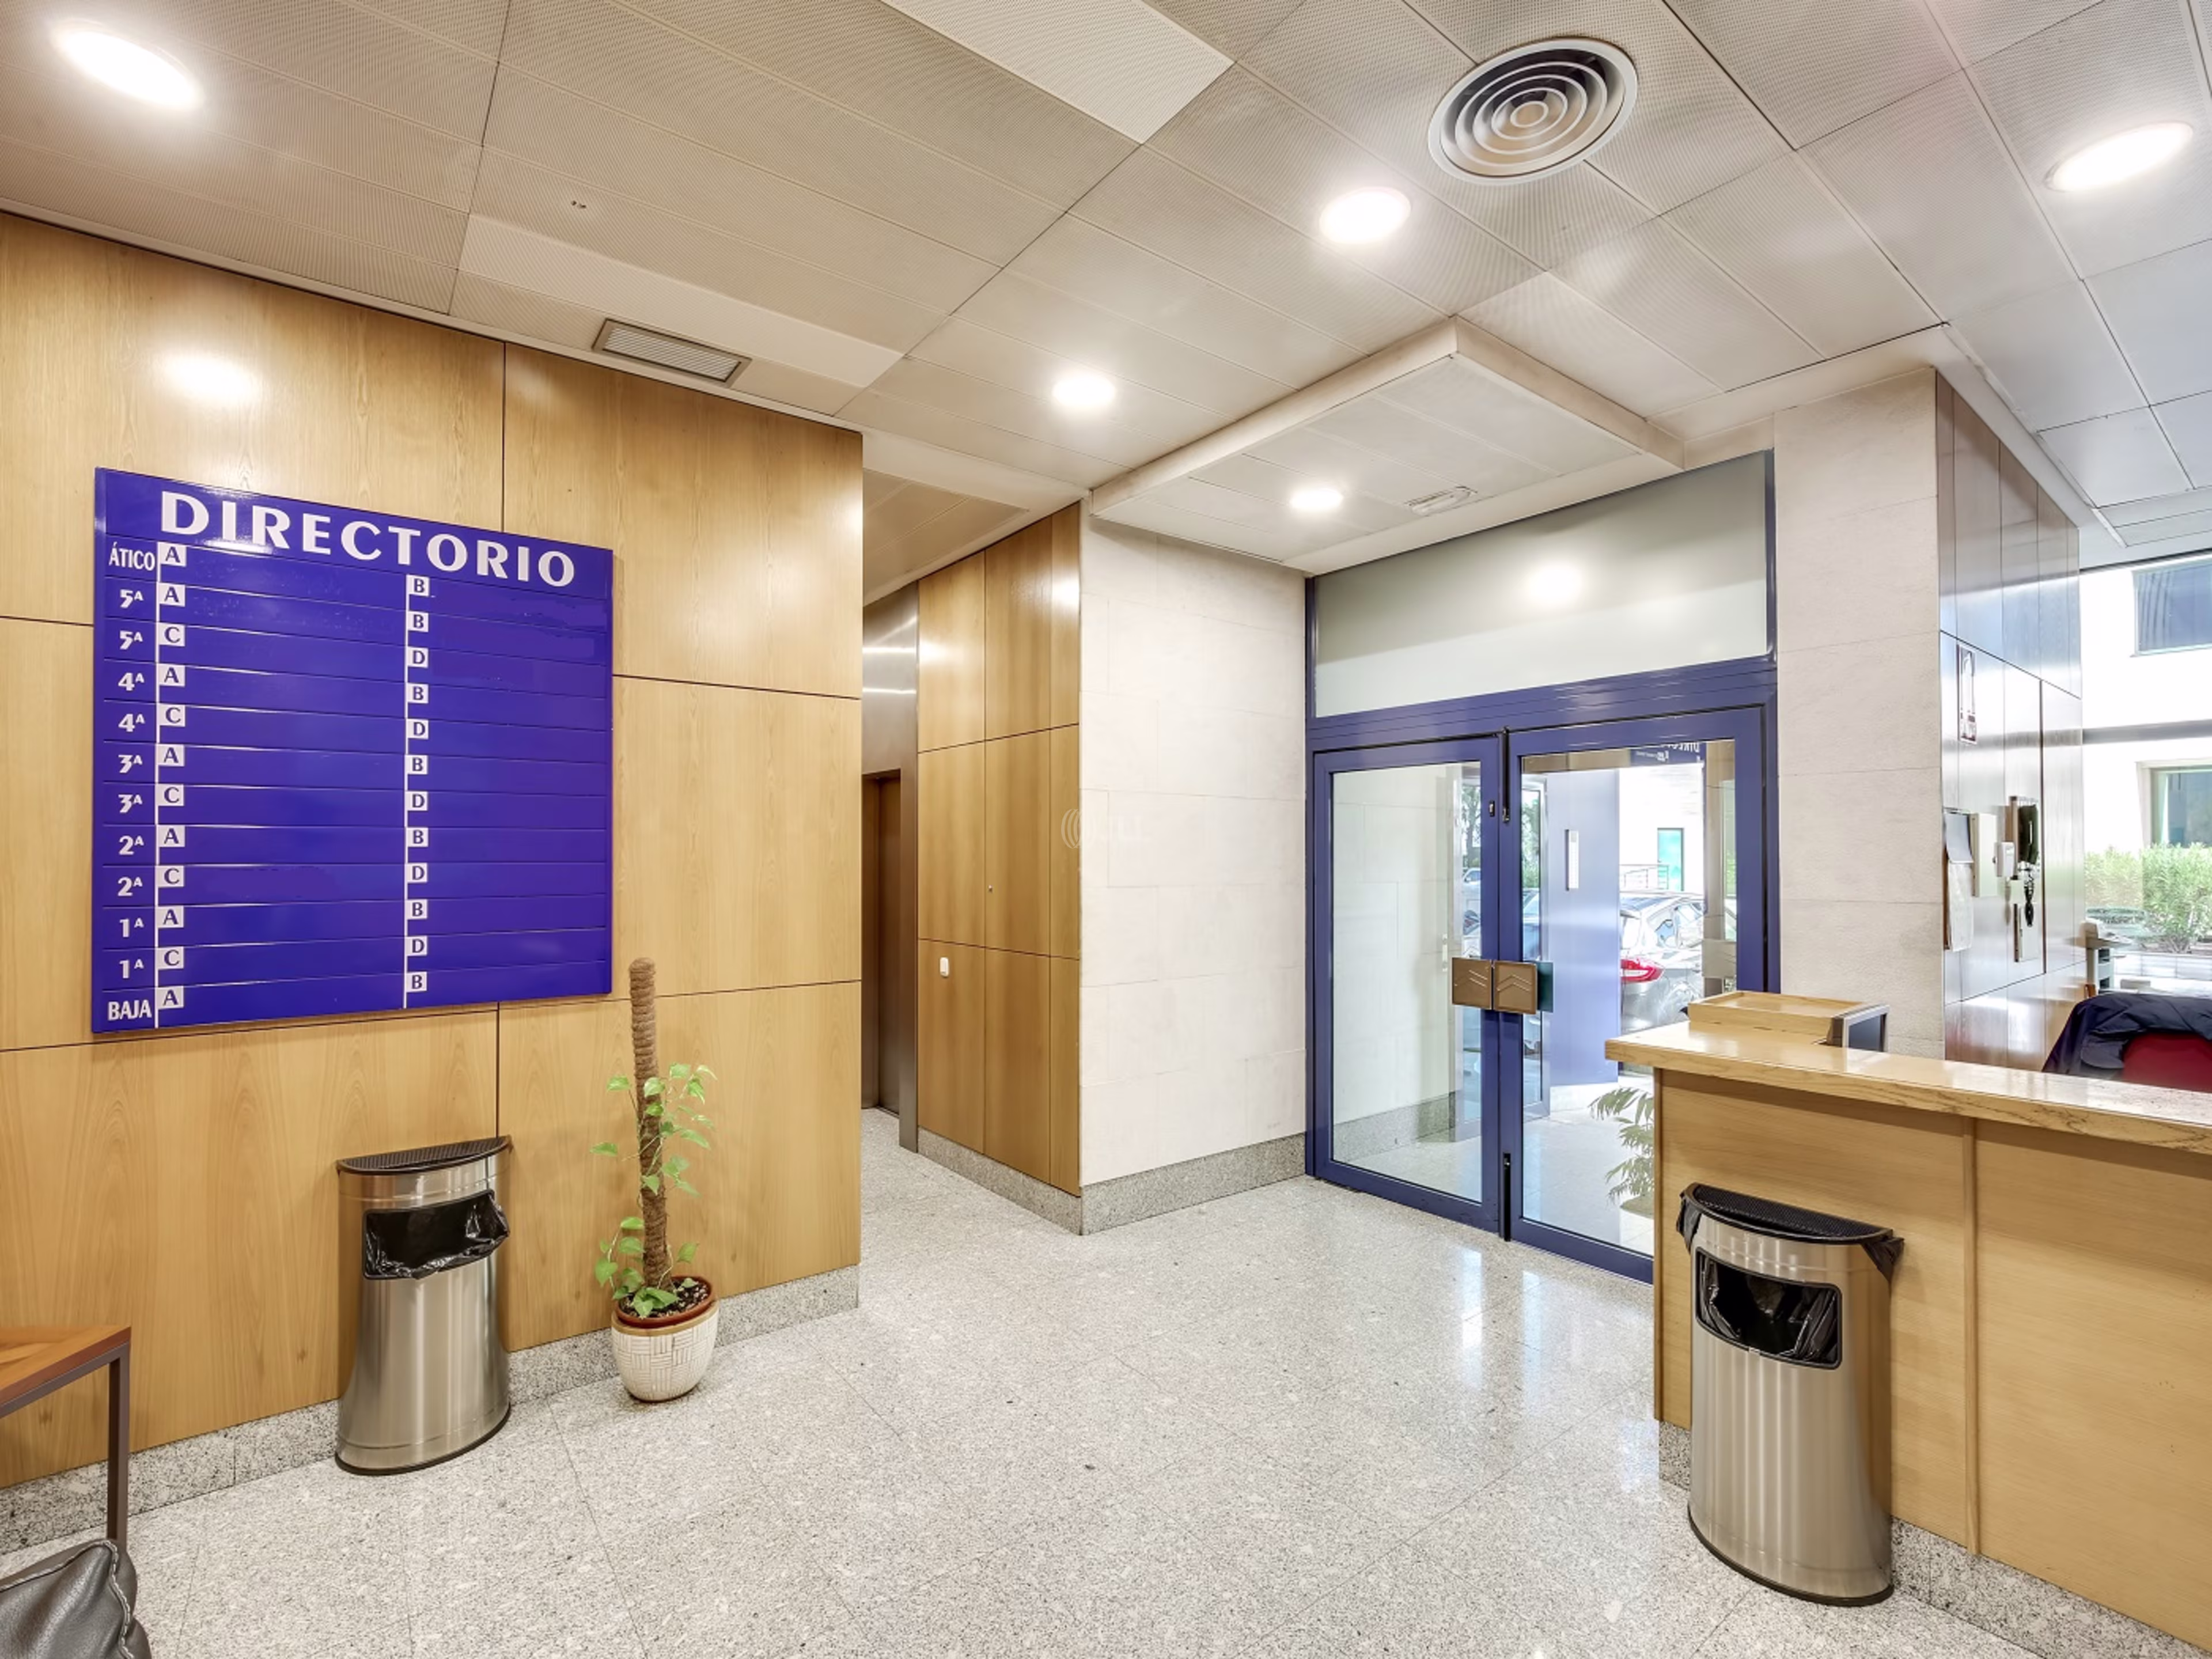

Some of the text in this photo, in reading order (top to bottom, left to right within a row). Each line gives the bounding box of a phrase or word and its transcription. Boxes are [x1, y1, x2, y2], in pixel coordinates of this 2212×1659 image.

[161, 490, 575, 587] DIRECTORIO
[108, 541, 180, 571] ÁTICO A
[414, 578, 425, 593] B
[164, 586, 179, 603] A
[413, 614, 424, 628] B
[164, 627, 180, 643] C
[412, 650, 425, 664] D
[164, 667, 179, 683] A
[413, 686, 424, 700] B
[165, 707, 181, 724] C
[413, 722, 426, 736] D
[164, 747, 179, 763] A
[412, 757, 423, 771] B
[164, 786, 179, 804] C
[412, 794, 425, 808] D
[164, 828, 179, 844] A
[413, 830, 424, 844] B
[164, 868, 180, 884] C
[412, 866, 425, 880] D
[163, 909, 179, 925] A
[412, 902, 423, 916] B
[412, 938, 425, 953] D
[164, 949, 179, 966] C
[412, 975, 422, 989] B
[108, 989, 179, 1021] BAJA A
